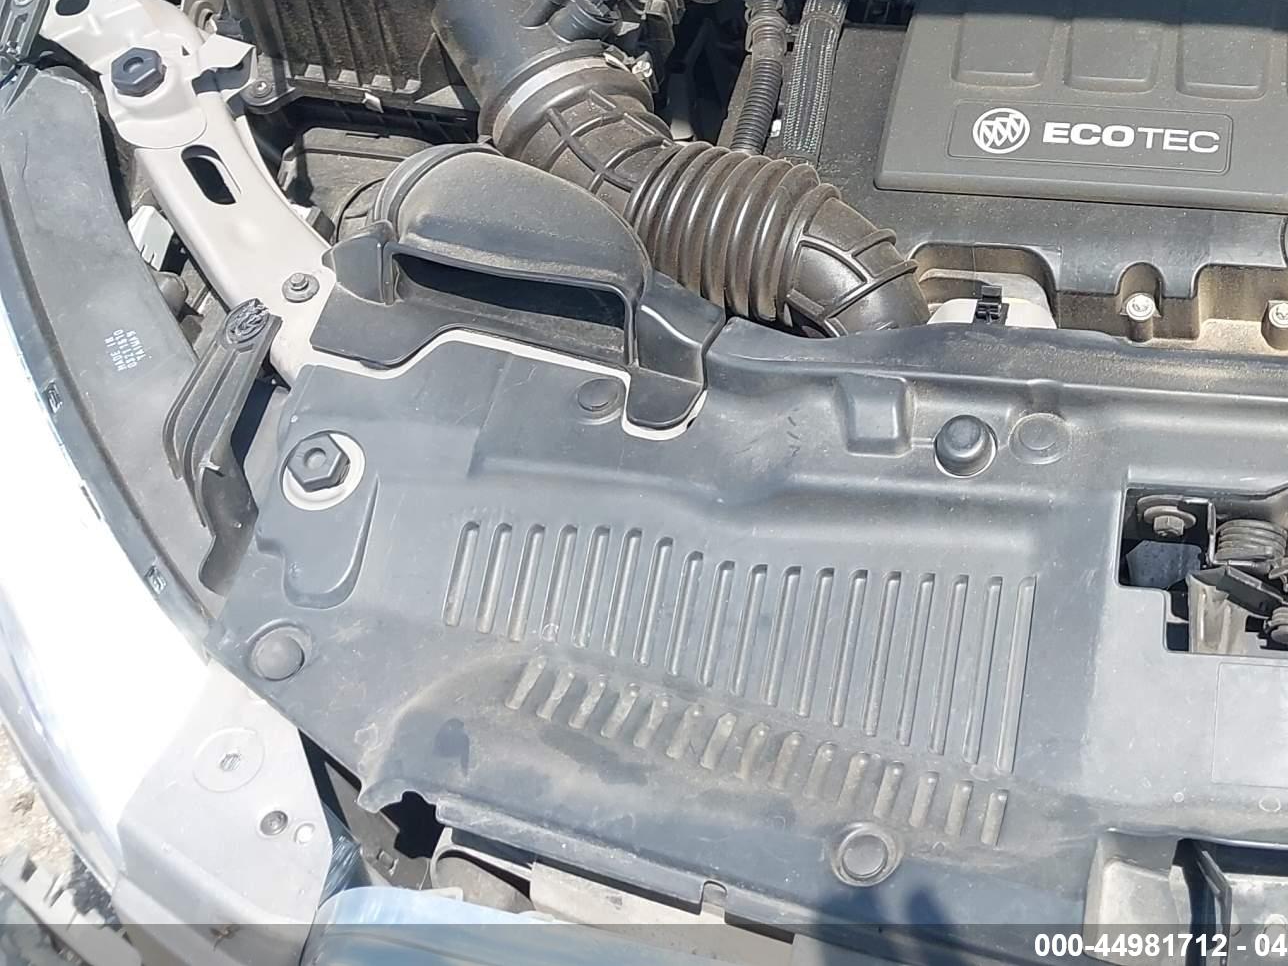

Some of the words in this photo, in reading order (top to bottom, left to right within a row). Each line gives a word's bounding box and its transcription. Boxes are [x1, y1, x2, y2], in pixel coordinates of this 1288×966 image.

[1042, 121, 1220, 153] ECOTEC
[104, 336, 117, 348] IN
[126, 330, 147, 361] TAIWAN
[110, 349, 127, 372] MADE
